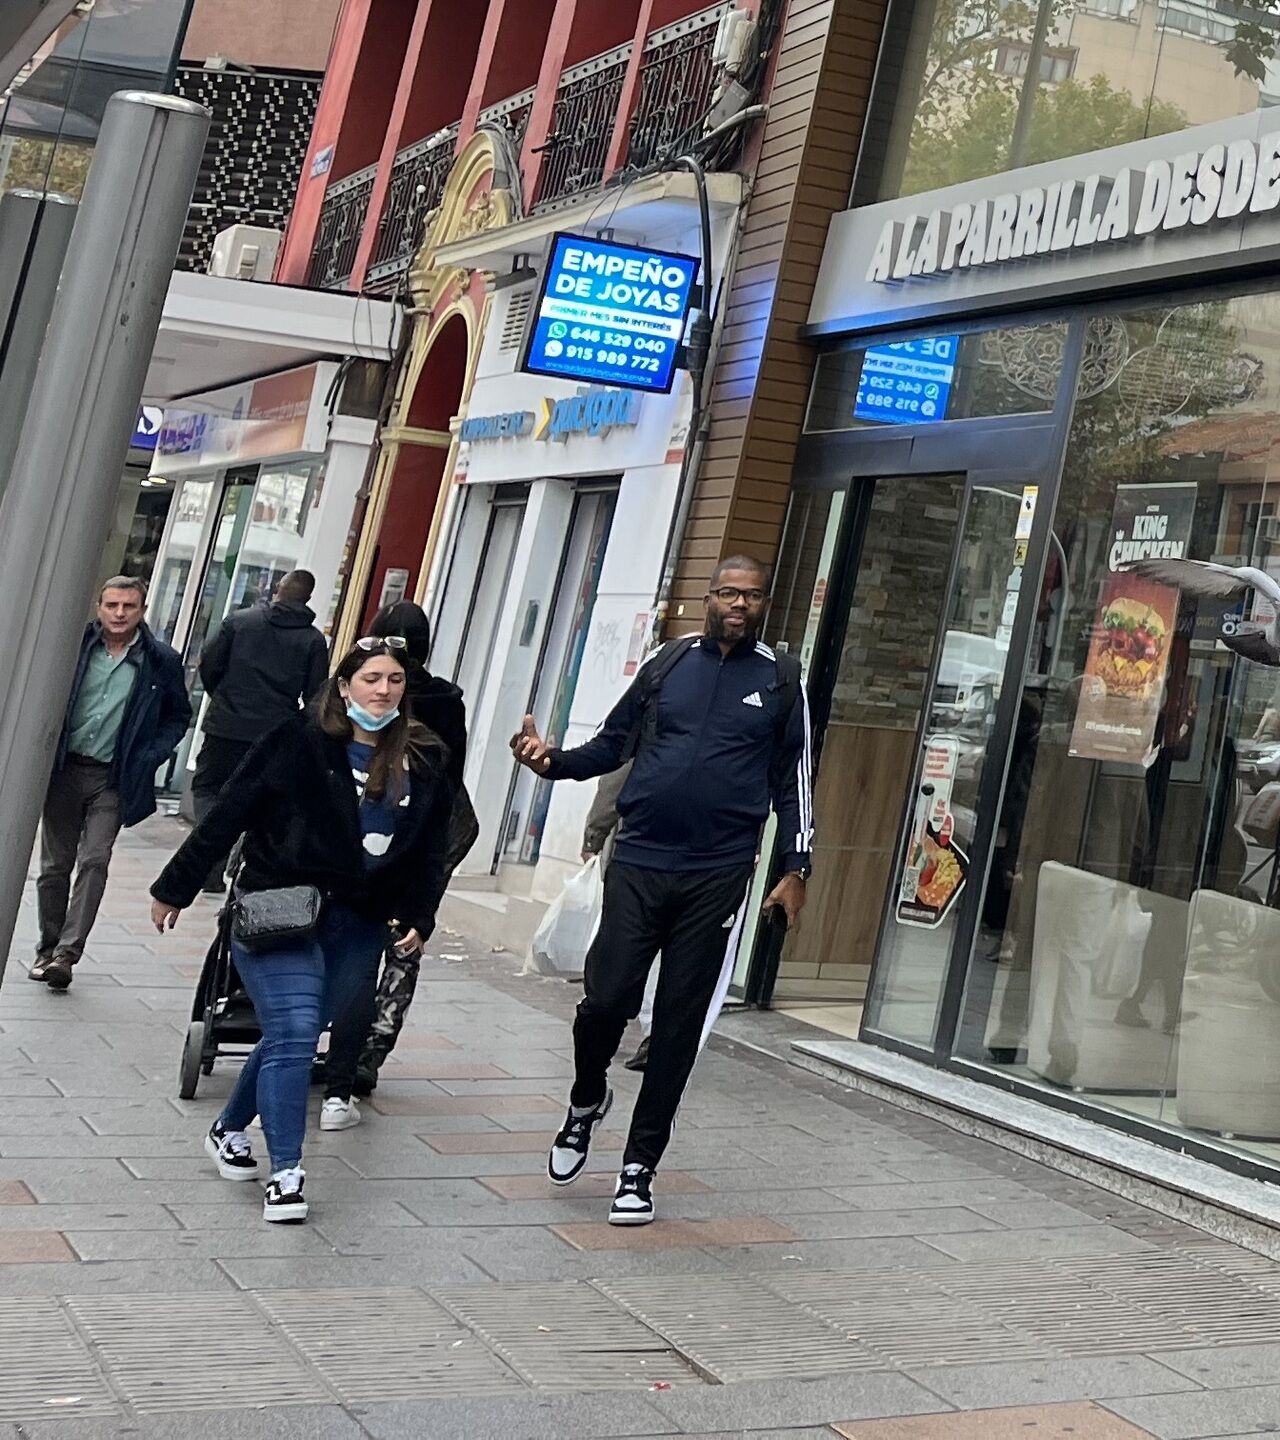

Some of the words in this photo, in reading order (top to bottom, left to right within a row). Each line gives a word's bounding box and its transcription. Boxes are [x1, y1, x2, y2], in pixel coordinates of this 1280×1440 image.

[866, 220, 895, 283] A
[894, 210, 944, 279] LA
[942, 167, 1134, 271] PARRILLA
[562, 247, 686, 289] EMPEÑO
[555, 273, 594, 298] DE
[596, 281, 681, 313] JOYAS
[590, 310, 610, 322] MES
[612, 314, 630, 324] SIN
[566, 344, 594, 361] 915
[630, 355, 660, 372] 772
[634, 338, 666, 354] 040
[1131, 515, 1169, 540] KING
[1109, 540, 1184, 572] CHICKEN
